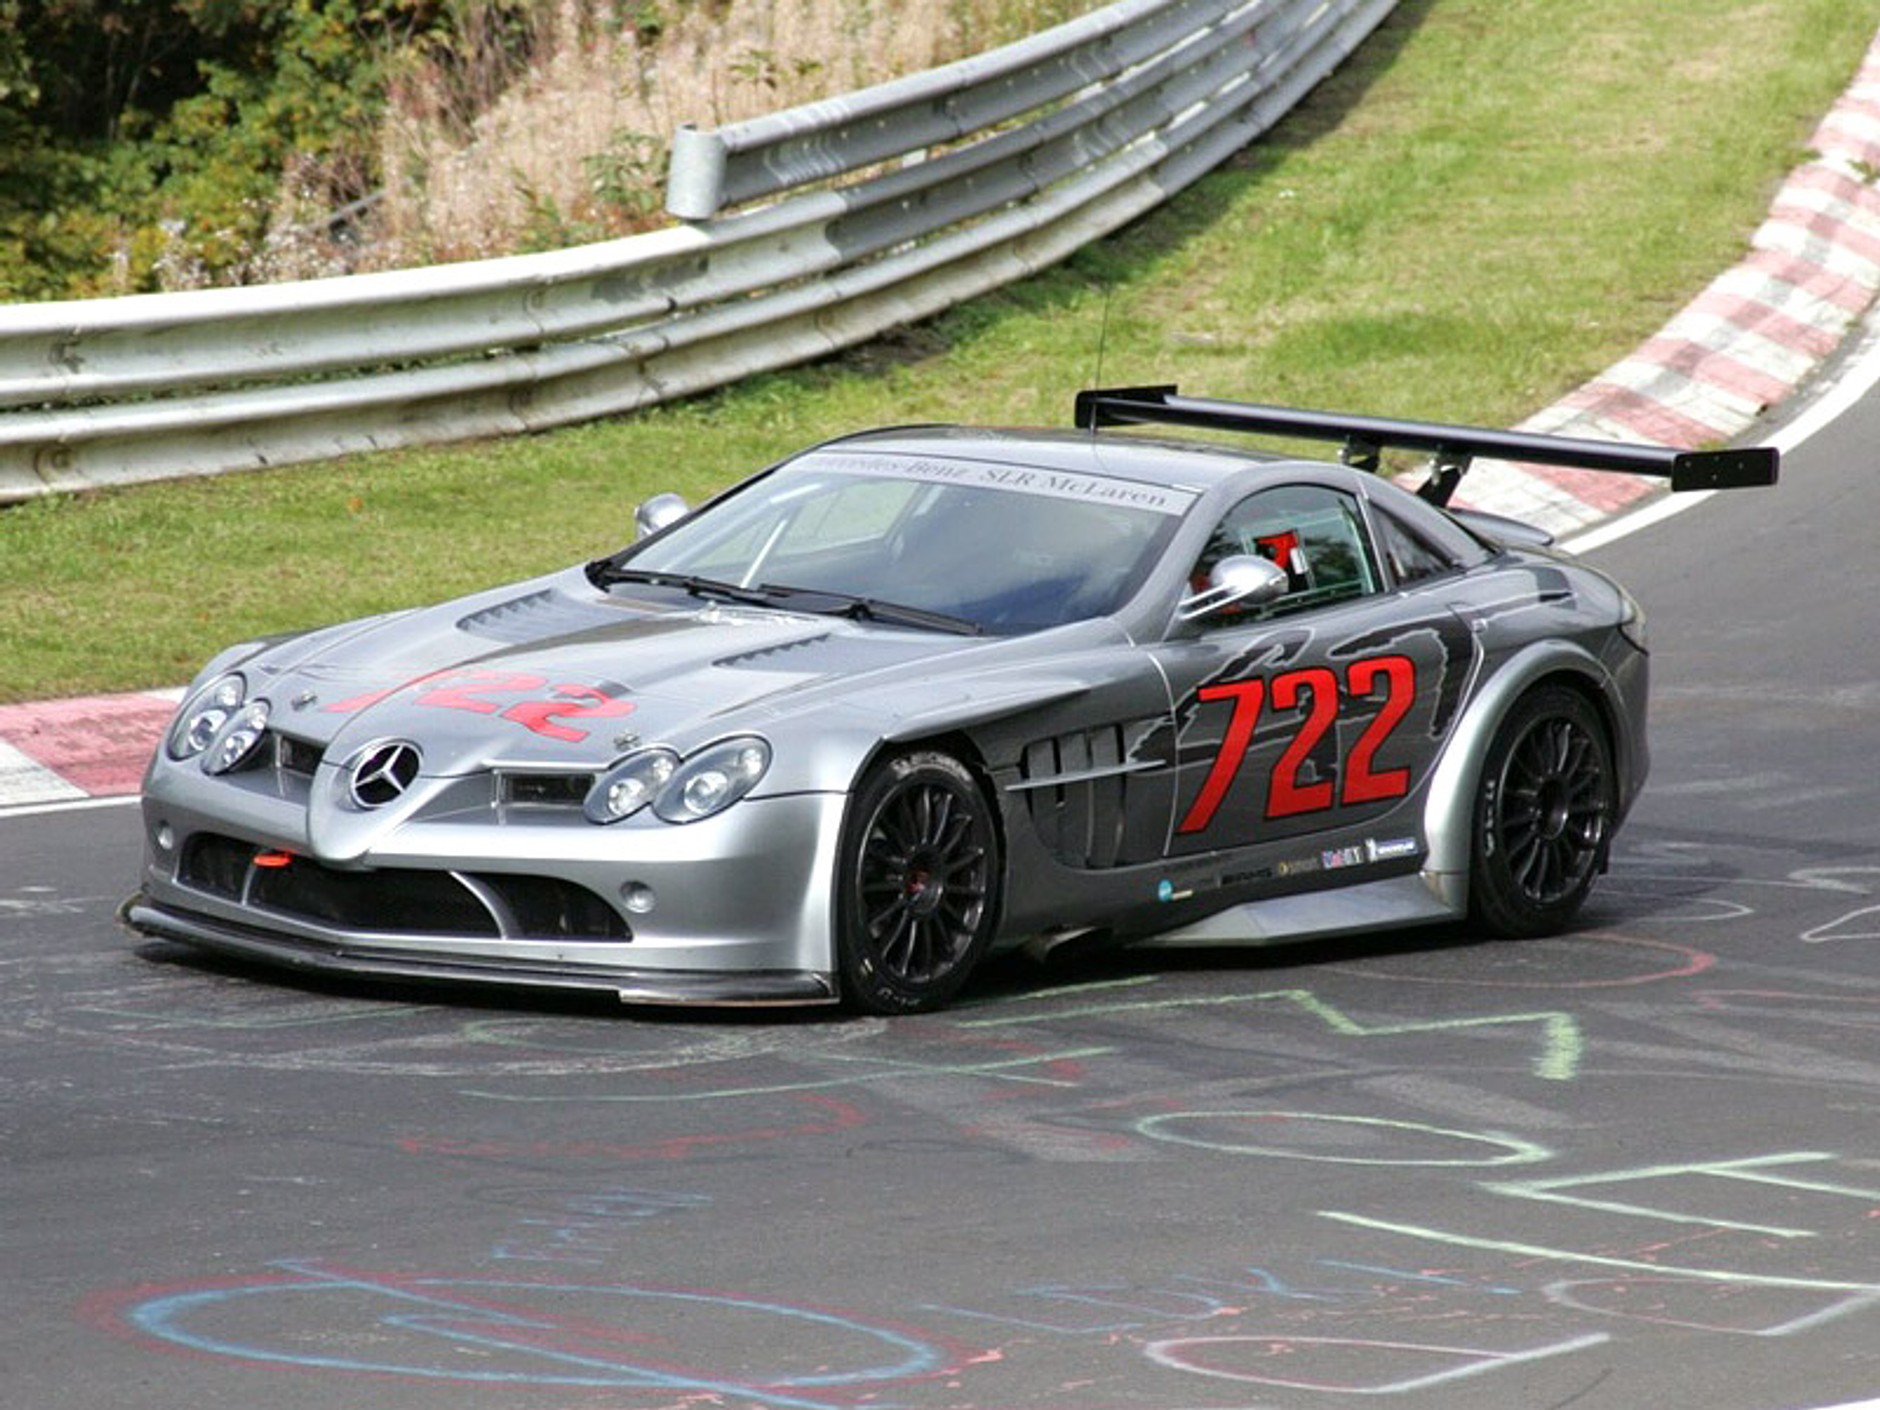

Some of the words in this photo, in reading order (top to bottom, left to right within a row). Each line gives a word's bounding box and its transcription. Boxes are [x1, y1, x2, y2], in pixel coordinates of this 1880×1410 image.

[978, 468, 1036, 488] SLR
[1042, 475, 1167, 508] McLaren
[319, 669, 638, 743] 722
[1174, 655, 1416, 835] 722
